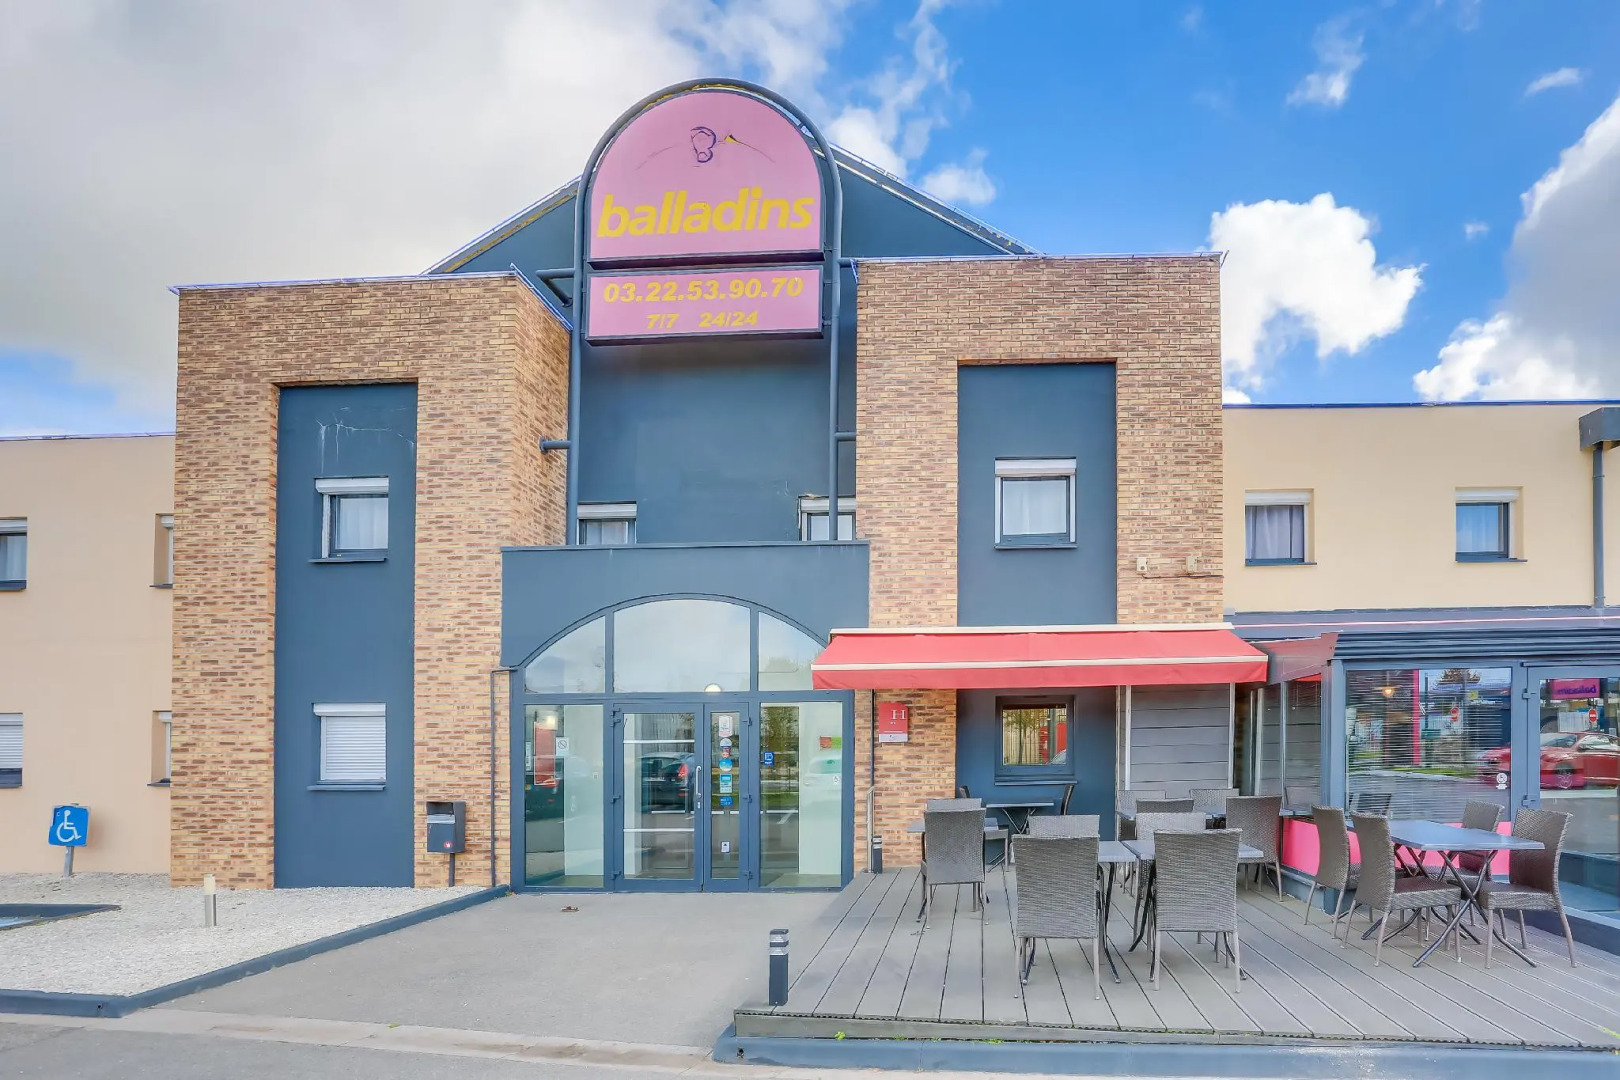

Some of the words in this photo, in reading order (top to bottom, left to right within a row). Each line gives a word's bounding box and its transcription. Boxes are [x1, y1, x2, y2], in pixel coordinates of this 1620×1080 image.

[597, 187, 814, 237] balladins
[604, 277, 803, 302] 03.22.53.90.70
[647, 314, 679, 329] 7/7
[699, 311, 758, 327] 24/24
